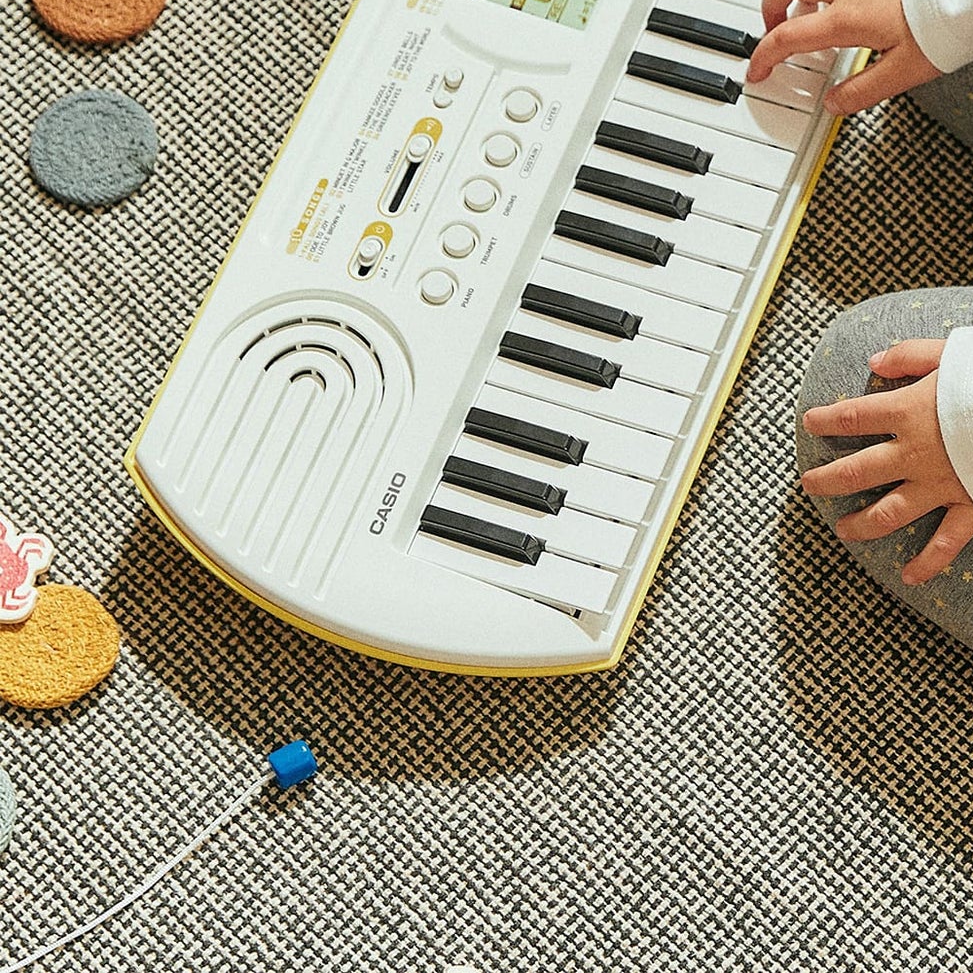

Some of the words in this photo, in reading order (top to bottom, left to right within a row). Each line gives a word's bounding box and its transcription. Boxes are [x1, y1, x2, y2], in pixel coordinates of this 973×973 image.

[377, 87, 401, 132] GREENSLEEVES
[545, 106, 556, 125] LAYER
[369, 118, 379, 130] THE
[340, 166, 354, 190] TWINKLE
[352, 140, 366, 164] TWINKLE
[384, 148, 398, 174] VOLUME
[523, 147, 538, 172] SUSTAIN
[347, 174, 359, 192] LITTLE
[356, 158, 367, 173] STAR
[288, 227, 303, 242] 10
[301, 185, 324, 223] SONGS
[502, 193, 517, 216] DRUMS
[315, 230, 324, 239] TO
[317, 236, 329, 255] LITTLE
[327, 214, 339, 234] BROWN
[319, 219, 329, 230] JOY
[309, 240, 320, 252] ODE
[479, 236, 497, 265] TRUMPET
[461, 287, 474, 308] PIANO
[369, 472, 406, 534] CASIO
